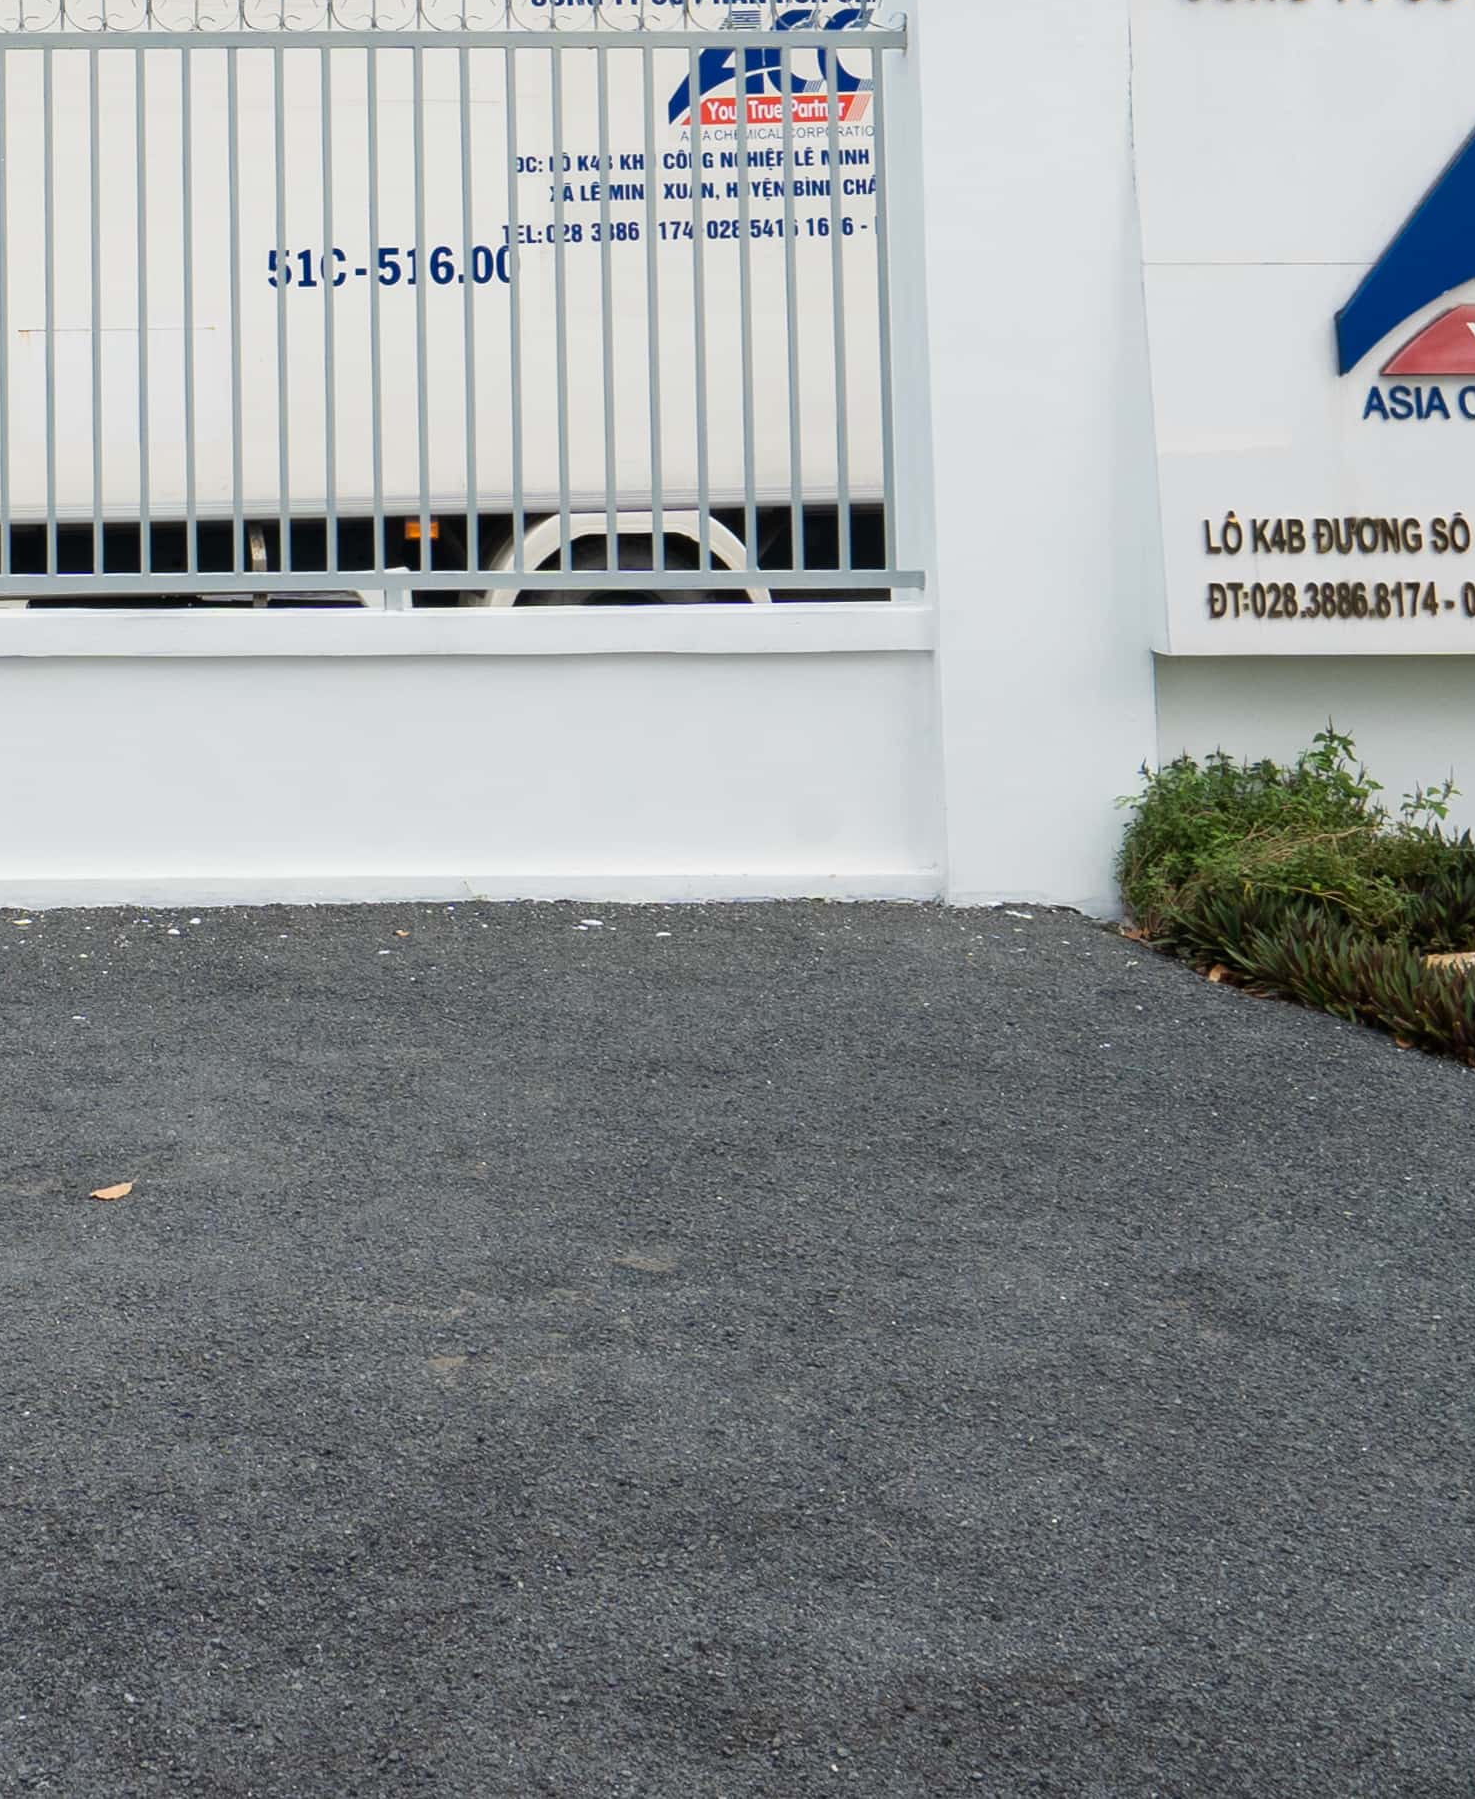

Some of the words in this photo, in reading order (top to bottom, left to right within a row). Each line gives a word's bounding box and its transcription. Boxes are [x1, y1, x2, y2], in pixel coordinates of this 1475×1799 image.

[707, 101, 739, 121] You
[748, 100, 783, 120] True
[791, 99, 845, 118] Partnr
[619, 153, 647, 171] KH
[794, 147, 814, 166] LÊ
[580, 181, 601, 201] LÊ
[609, 183, 647, 201] MIN
[663, 182, 720, 201] XUN,
[726, 177, 785, 201] HYỆN
[655, 220, 694, 241] 174
[806, 216, 854, 237] 166
[1363, 385, 1451, 420] ASIA
[1251, 517, 1306, 554] K4B
